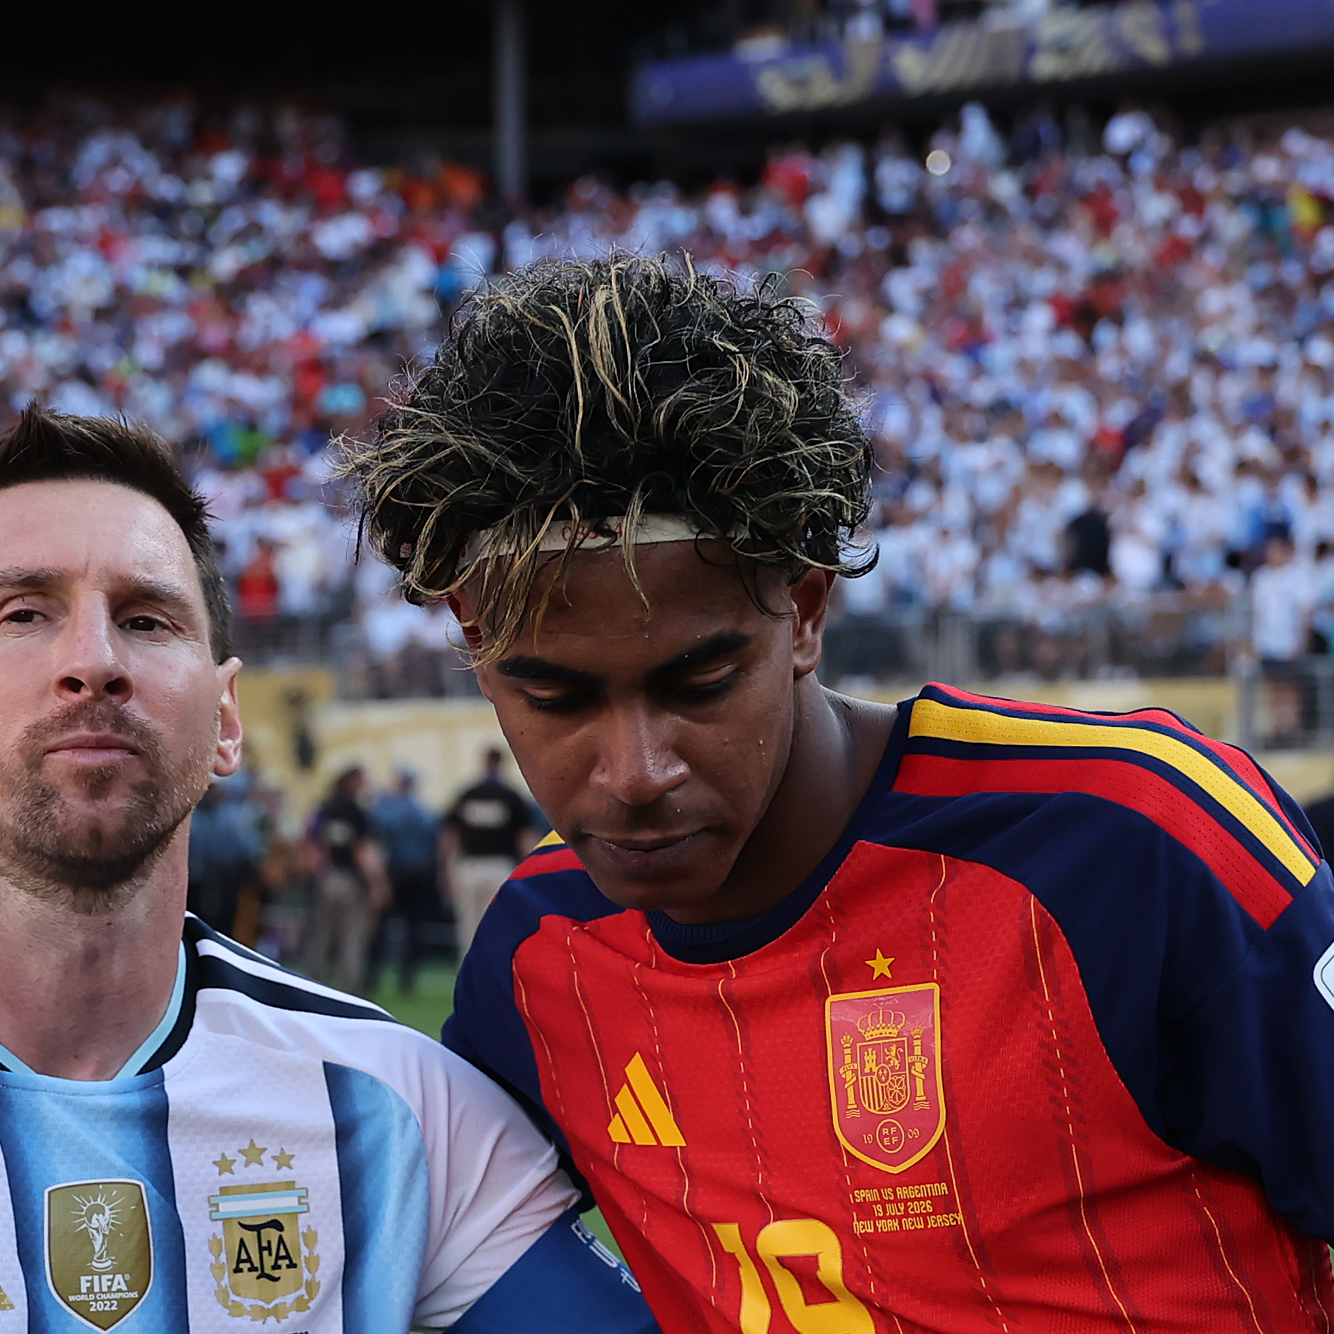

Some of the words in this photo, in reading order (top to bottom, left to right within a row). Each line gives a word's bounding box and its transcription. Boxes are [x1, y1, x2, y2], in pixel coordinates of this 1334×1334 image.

[854, 1189, 880, 1203] SPAIN
[896, 1182, 948, 1199] ARGENTINA
[872, 1204, 884, 1217] 19
[886, 1202, 905, 1216] JULY
[907, 1200, 933, 1214] 2026
[853, 1220, 875, 1234] NEW
[876, 1218, 900, 1233] YORK
[902, 1216, 925, 1231] NEW
[927, 1212, 962, 1229] JERSEY
[233, 1219, 297, 1282] AFA
[68, 1293, 95, 1302] WORLD
[96, 1291, 139, 1301] CHAMPIONS
[89, 1300, 118, 1311] 2022
